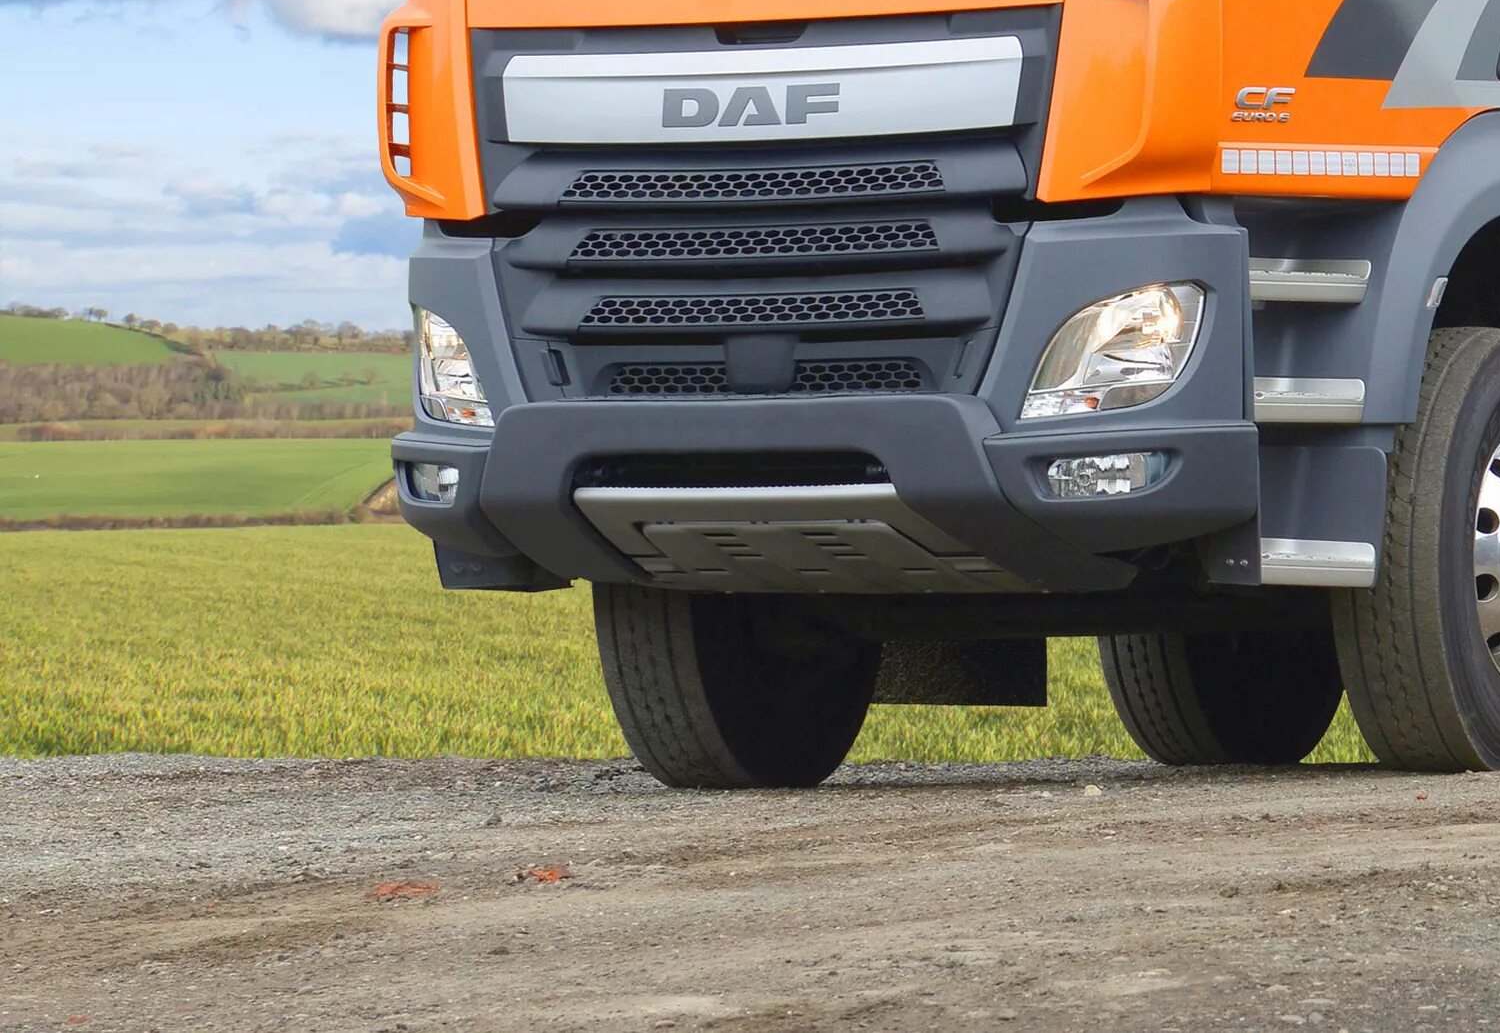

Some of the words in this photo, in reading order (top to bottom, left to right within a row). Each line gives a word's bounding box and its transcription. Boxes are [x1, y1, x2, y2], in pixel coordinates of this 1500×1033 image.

[662, 82, 841, 129] DAF
[1236, 86, 1296, 109] CF
[1231, 111, 1278, 122] EURO
[1278, 112, 1290, 123] 6
